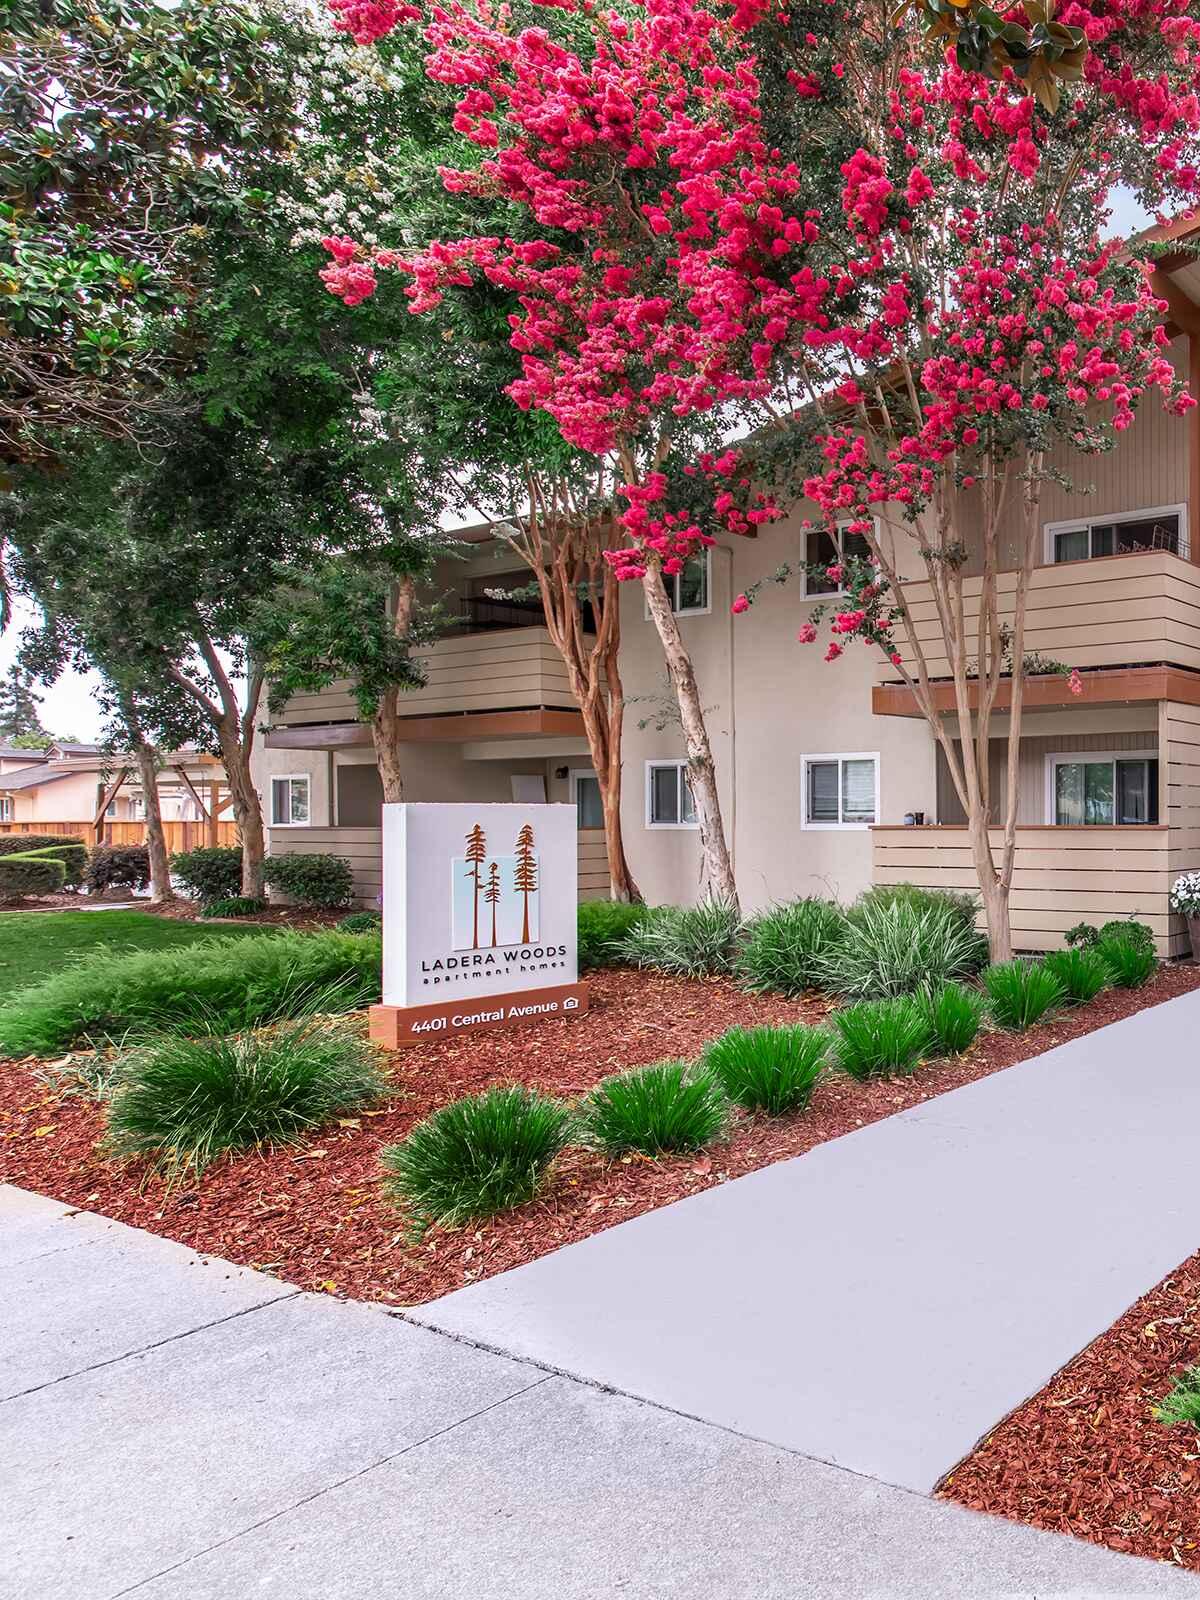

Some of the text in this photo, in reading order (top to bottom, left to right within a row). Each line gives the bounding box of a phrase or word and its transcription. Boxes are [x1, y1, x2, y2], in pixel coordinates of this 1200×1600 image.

[421, 945, 567, 972] LADERA WOODS
[423, 961, 566, 985] apartment homes
[411, 1002, 559, 1034] 4401 Central Avenue
